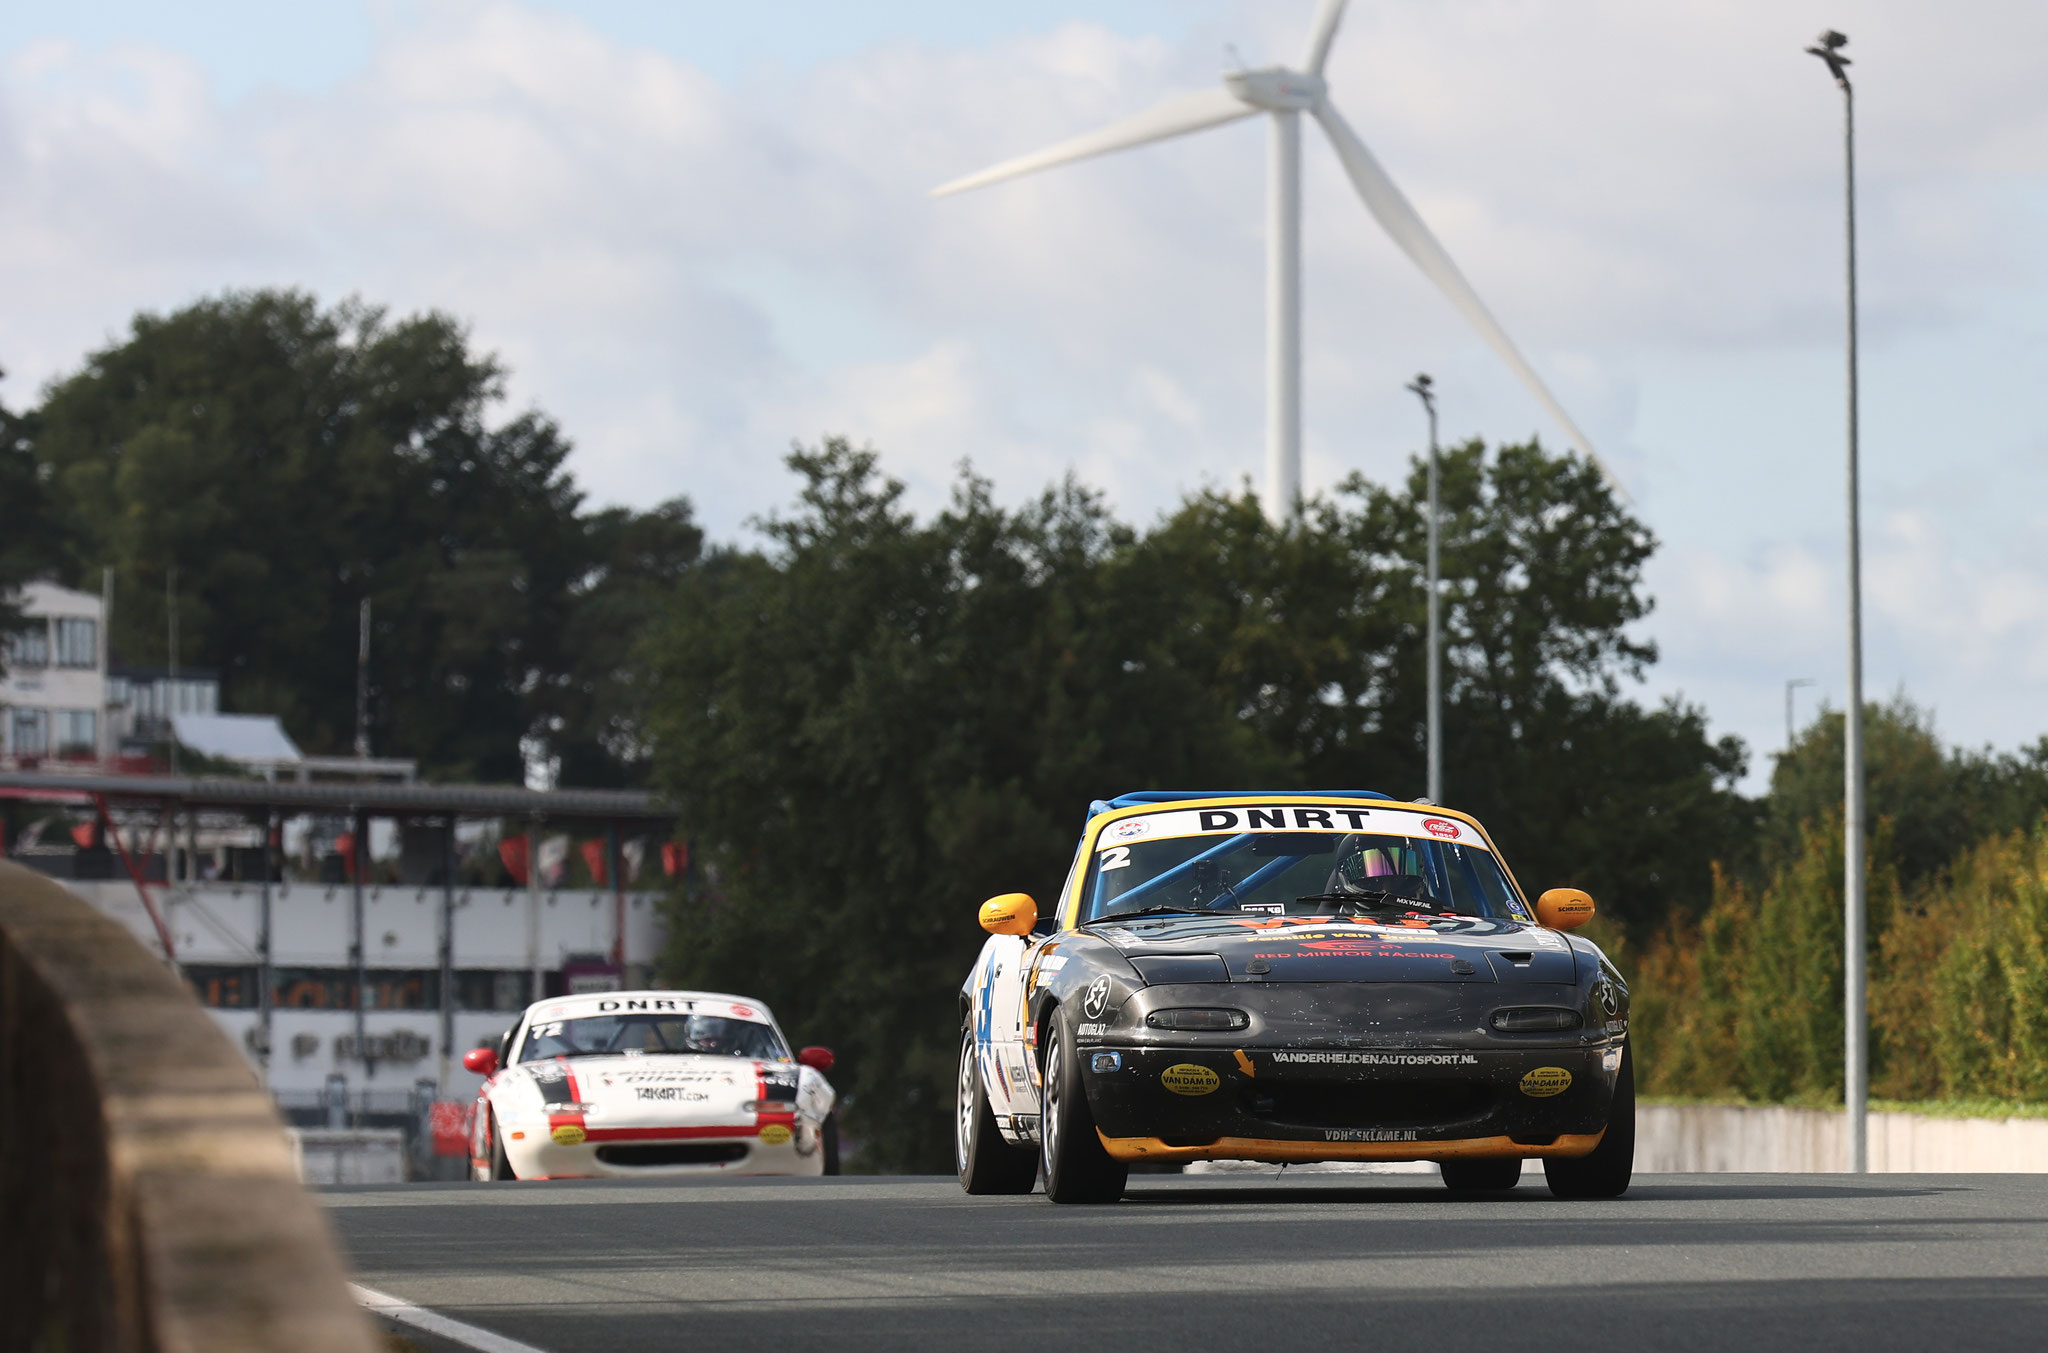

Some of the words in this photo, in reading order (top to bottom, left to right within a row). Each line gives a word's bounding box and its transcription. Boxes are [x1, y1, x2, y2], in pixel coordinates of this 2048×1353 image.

[1199, 809, 1370, 831] DNRT
[1101, 847, 1130, 873] 2
[1246, 933, 1324, 942] Familie
[1377, 951, 1456, 959] RACING
[599, 1000, 700, 1012] DNRT
[531, 1022, 563, 1040] 72
[1272, 1052, 1479, 1065] VANDERHEIJDENAUTOSPORT.NL
[1163, 1076, 1181, 1084] VAN
[1183, 1077, 1204, 1085] DAM
